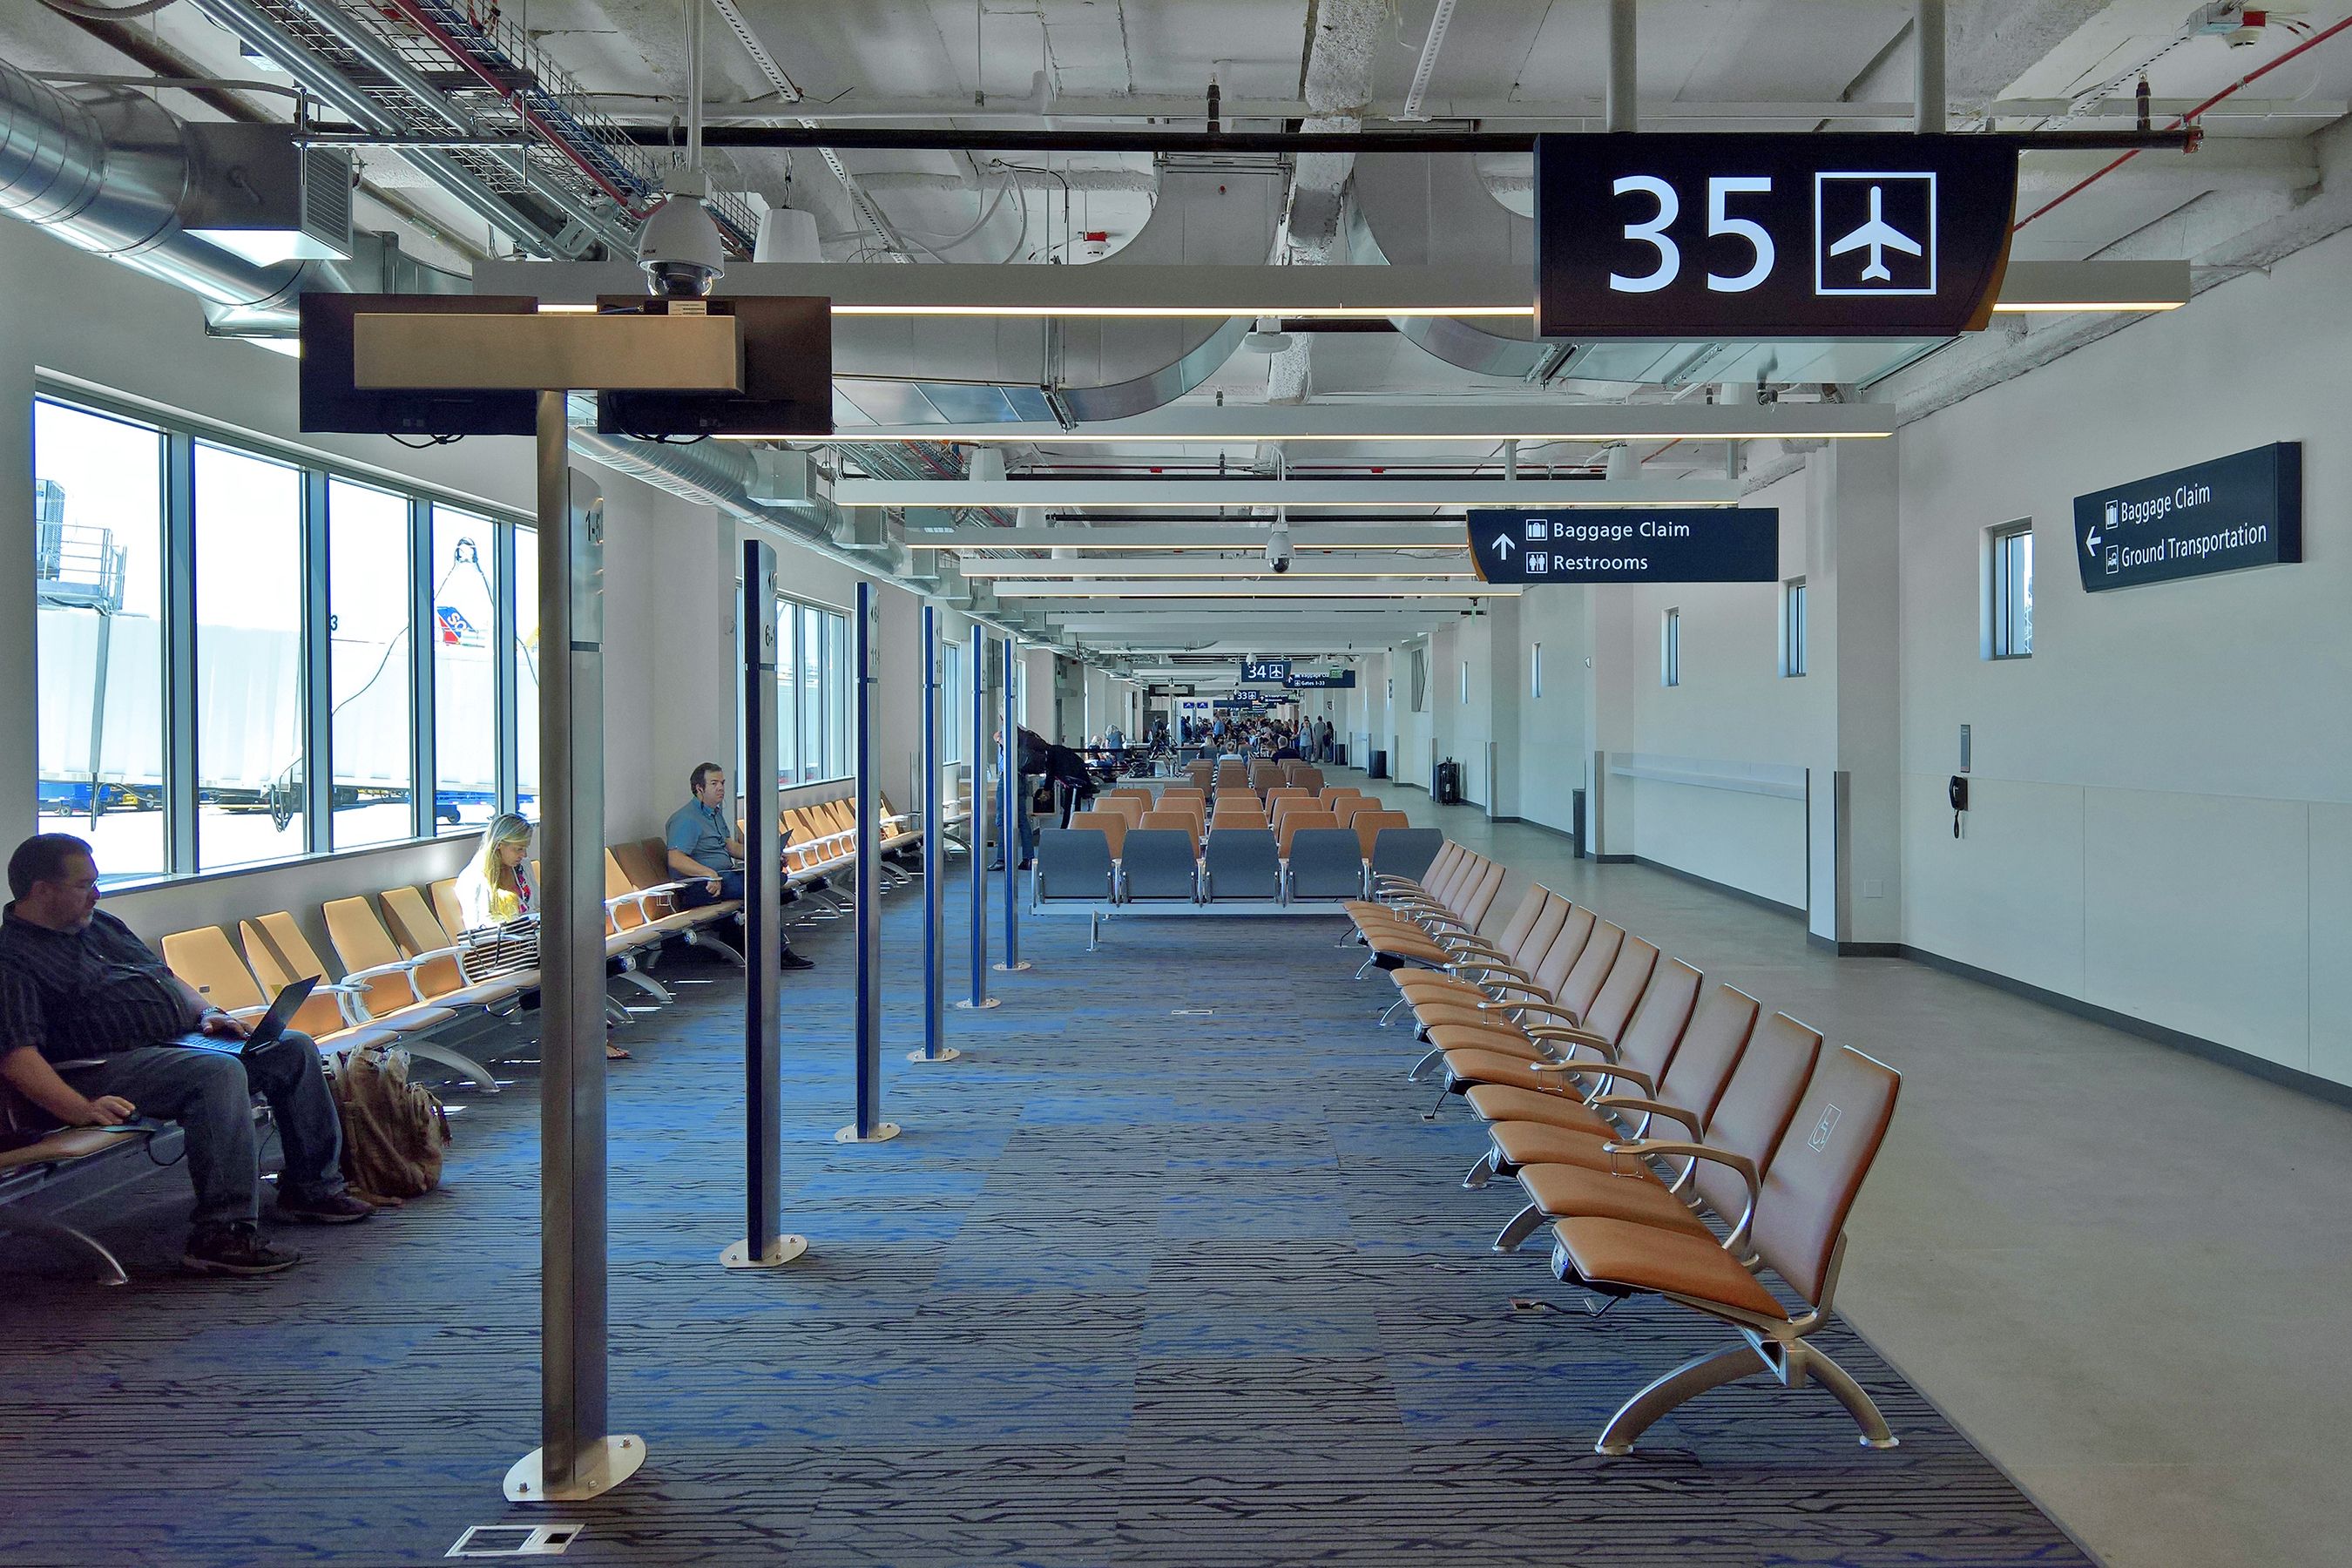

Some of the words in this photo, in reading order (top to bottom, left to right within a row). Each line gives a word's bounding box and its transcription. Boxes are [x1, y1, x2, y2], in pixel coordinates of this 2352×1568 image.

[1609, 175, 1775, 294] 35
[2121, 497, 2172, 524] Baggage
[2175, 483, 2211, 510] Claim
[1553, 522, 1633, 542] Baggage
[1639, 520, 1690, 537] Claim
[2121, 538, 2166, 567] Ground
[2167, 523, 2268, 559] Transportation
[1554, 555, 1648, 571] Restrooms
[1247, 665, 1267, 679] 34
[1237, 692, 1247, 700] 33
